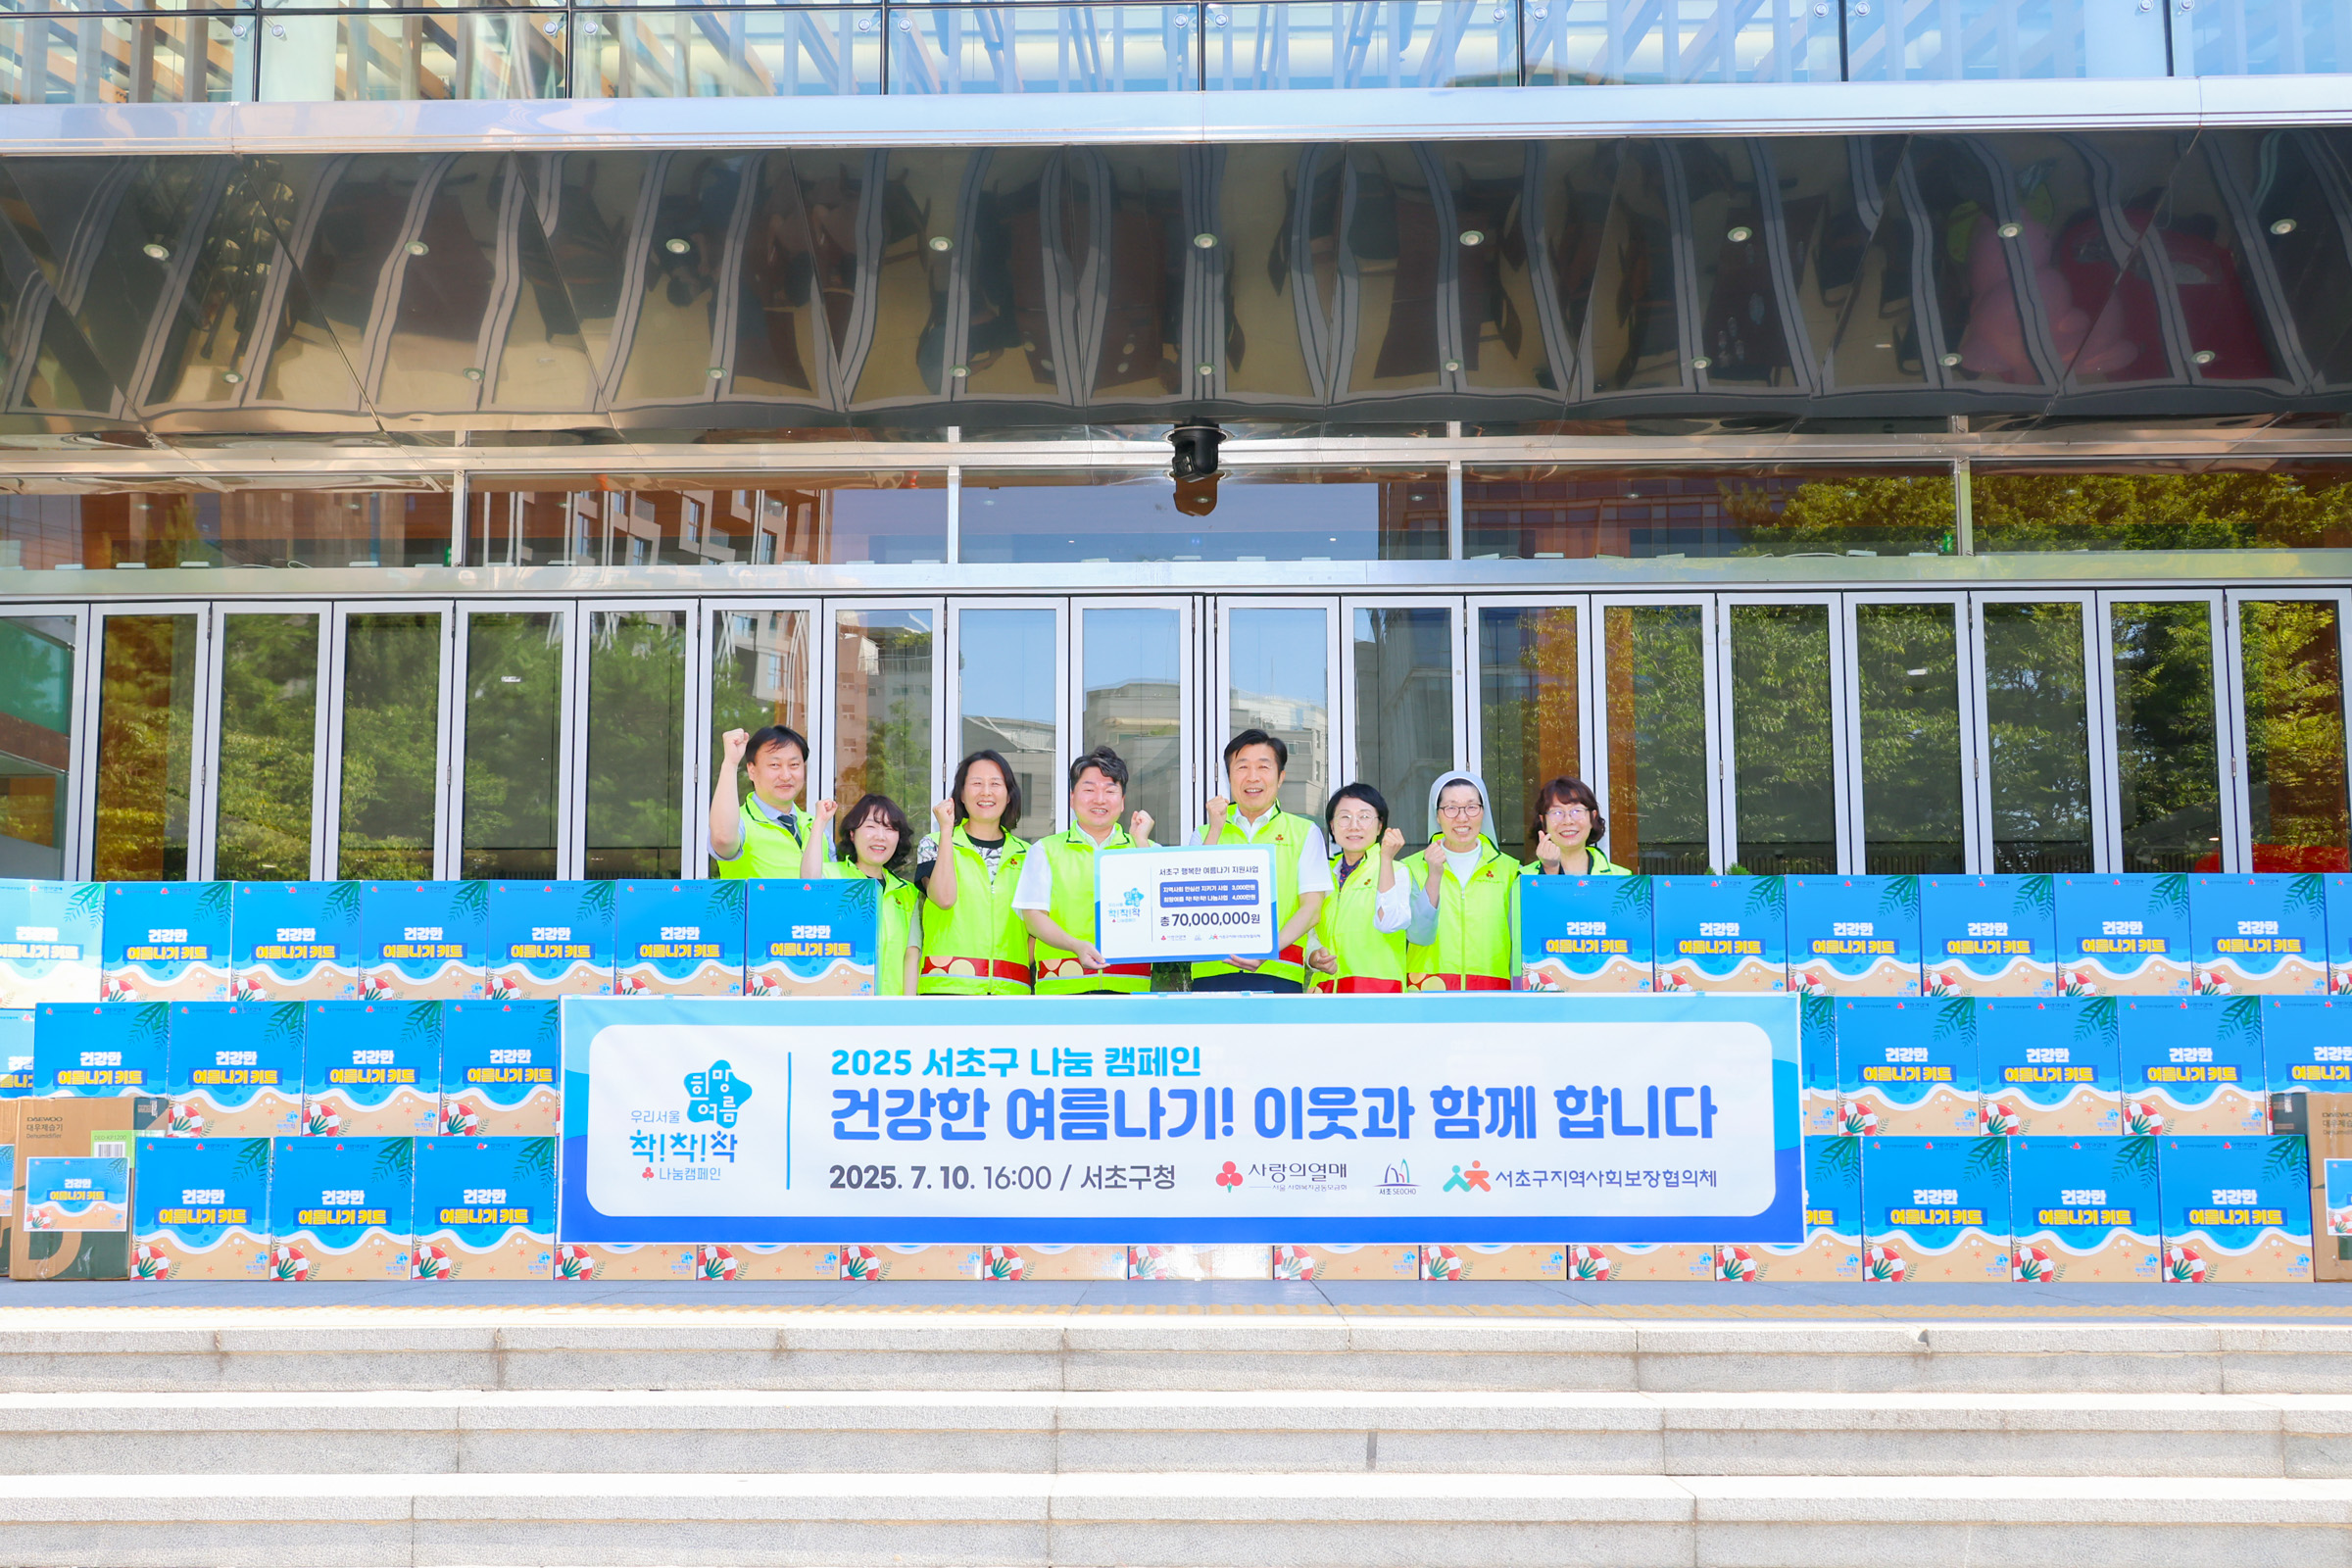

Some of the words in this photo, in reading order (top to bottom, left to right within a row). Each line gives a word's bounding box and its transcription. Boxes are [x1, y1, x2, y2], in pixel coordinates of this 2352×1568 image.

[1202, 866, 1230, 875] 여름나기
[1232, 865, 1259, 874] 지원사업
[1159, 916, 1170, 927] 총
[1171, 911, 1260, 927] 70,000,000원
[148, 928, 188, 943] 건강한
[276, 927, 317, 942] 건강한
[404, 926, 444, 941] 건강한
[531, 926, 571, 941] 건강한
[661, 926, 701, 941] 건강한
[791, 925, 832, 940] 건강한
[1566, 921, 1607, 936] 건강한
[1699, 922, 1740, 937] 건강한
[1833, 922, 1874, 937] 건강한
[1967, 922, 2009, 937] 건강한
[2102, 920, 2144, 935] 건강한
[2237, 920, 2279, 935] 건강한
[127, 946, 179, 960] 여름나기
[181, 946, 208, 960] 키트
[256, 945, 309, 959] 여름나기
[310, 945, 336, 959] 키트
[383, 944, 436, 958] 여름나기
[437, 944, 464, 958] 키트
[511, 944, 564, 958] 여름나기
[564, 944, 591, 958] 키트
[640, 944, 693, 958] 여름나기
[694, 944, 720, 958] 키트
[770, 942, 823, 956] 여름나기
[824, 942, 852, 956] 키트
[1545, 938, 1600, 954] 여름나기
[1601, 938, 1629, 954] 키트
[1679, 939, 1733, 955] 여름나기
[1735, 939, 1762, 955] 키트
[1813, 939, 1867, 955] 여름나기
[1868, 939, 1895, 955] 키트
[1947, 940, 2002, 955] 여름나기
[2003, 940, 2031, 955] 키트
[2082, 938, 2137, 954] 여름나기
[2138, 938, 2166, 954] 키트
[2218, 938, 2273, 954] 여름나기
[2274, 938, 2302, 954] 키트
[79, 1051, 122, 1067] 건강한
[216, 1051, 258, 1066] 건강한
[352, 1050, 395, 1065] 건강한
[489, 1049, 532, 1064] 건강한
[830, 1049, 912, 1077] 2025
[921, 1046, 1020, 1078] 서초구
[1030, 1046, 1095, 1078] 나눔
[1103, 1045, 1201, 1078] 캠페인
[1885, 1047, 1929, 1062] 건강한
[2026, 1048, 2070, 1063] 건강한
[2169, 1047, 2214, 1063] 건강한
[8, 1055, 34, 1071] 건강
[57, 1069, 113, 1086] 여름나기
[115, 1069, 143, 1086] 키트
[193, 1069, 249, 1085] 여름나기
[250, 1069, 278, 1085] 키트
[329, 1068, 386, 1084] 여름나기
[387, 1068, 416, 1084] 키트
[467, 1067, 523, 1083] 여름나기
[524, 1067, 554, 1083] 키트
[1863, 1065, 1922, 1082] 여름나기
[1923, 1065, 1953, 1082] 키트
[2004, 1066, 2063, 1083] 여름나기
[2064, 1066, 2094, 1083] 키트
[2147, 1066, 2207, 1082] 여름나기
[2208, 1066, 2238, 1082] 키트
[2291, 1065, 2351, 1081] 여름나기
[690, 1069, 734, 1101] 희망
[630, 1109, 680, 1124] 우리서울
[698, 1096, 739, 1123] 여름
[830, 1087, 991, 1142] 건강한
[1005, 1086, 1235, 1142] 여름나기!
[1253, 1085, 1416, 1141] 이웃과
[1429, 1084, 1538, 1140] 함께
[1552, 1084, 1719, 1140] 합니다
[659, 1167, 721, 1181] 나눔캠페인
[829, 1164, 903, 1190] 2025.
[910, 1165, 932, 1190] 7.
[939, 1164, 976, 1191] 10.
[983, 1165, 1053, 1191] 16:00
[1080, 1164, 1176, 1191] 서초구청
[1248, 1162, 1348, 1184] 사랑의열매
[1494, 1168, 1717, 1189] 서초구지역사회보장협의체
[181, 1189, 225, 1204] 건강한
[321, 1190, 366, 1205] 건강한
[463, 1189, 507, 1204] 건강한
[1913, 1189, 1959, 1205] 건강한
[2061, 1189, 2107, 1205] 건강한
[2212, 1189, 2258, 1205] 건강한
[159, 1207, 217, 1225] 여름나기
[218, 1207, 247, 1225] 키트
[298, 1208, 357, 1226] 여름나기
[357, 1208, 388, 1226] 키트
[440, 1207, 499, 1225] 여름나기
[500, 1207, 529, 1225] 키트
[1890, 1208, 1951, 1225] 여름나기
[1952, 1208, 1984, 1225] 키트
[2038, 1208, 2099, 1226] 여름나기
[2100, 1208, 2132, 1226] 키트
[2189, 1208, 2251, 1226] 여름나기
[2252, 1208, 2284, 1226] 키트
